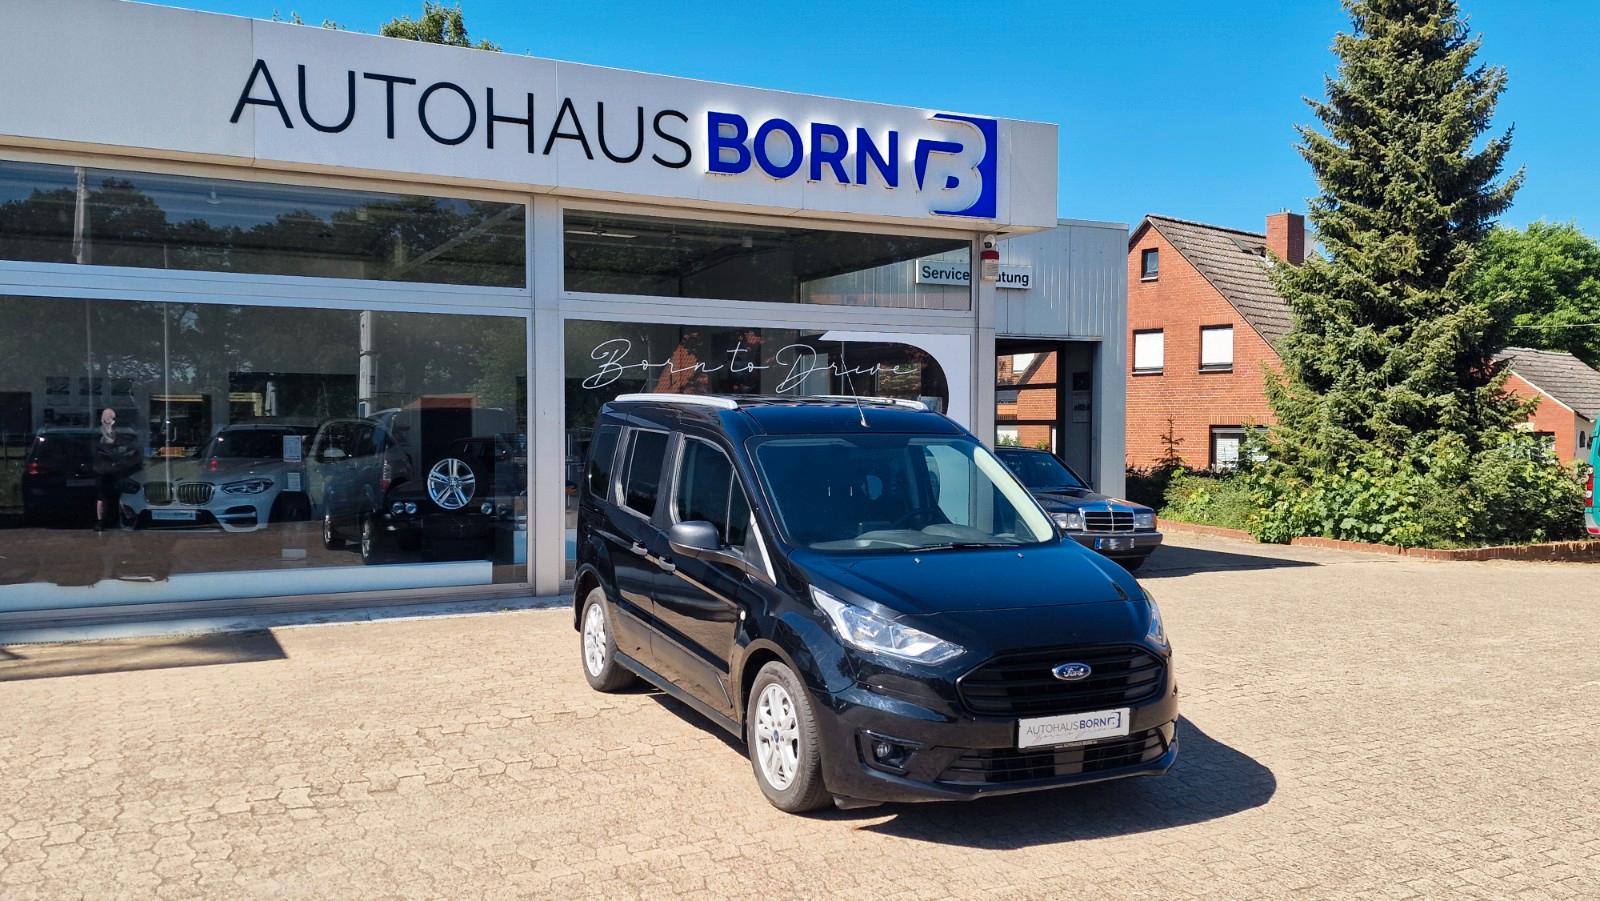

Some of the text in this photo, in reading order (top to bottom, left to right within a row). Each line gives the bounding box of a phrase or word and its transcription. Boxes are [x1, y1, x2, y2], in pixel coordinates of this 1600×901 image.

[922, 265, 970, 281] Service
[582, 338, 921, 394] Born to Drive
